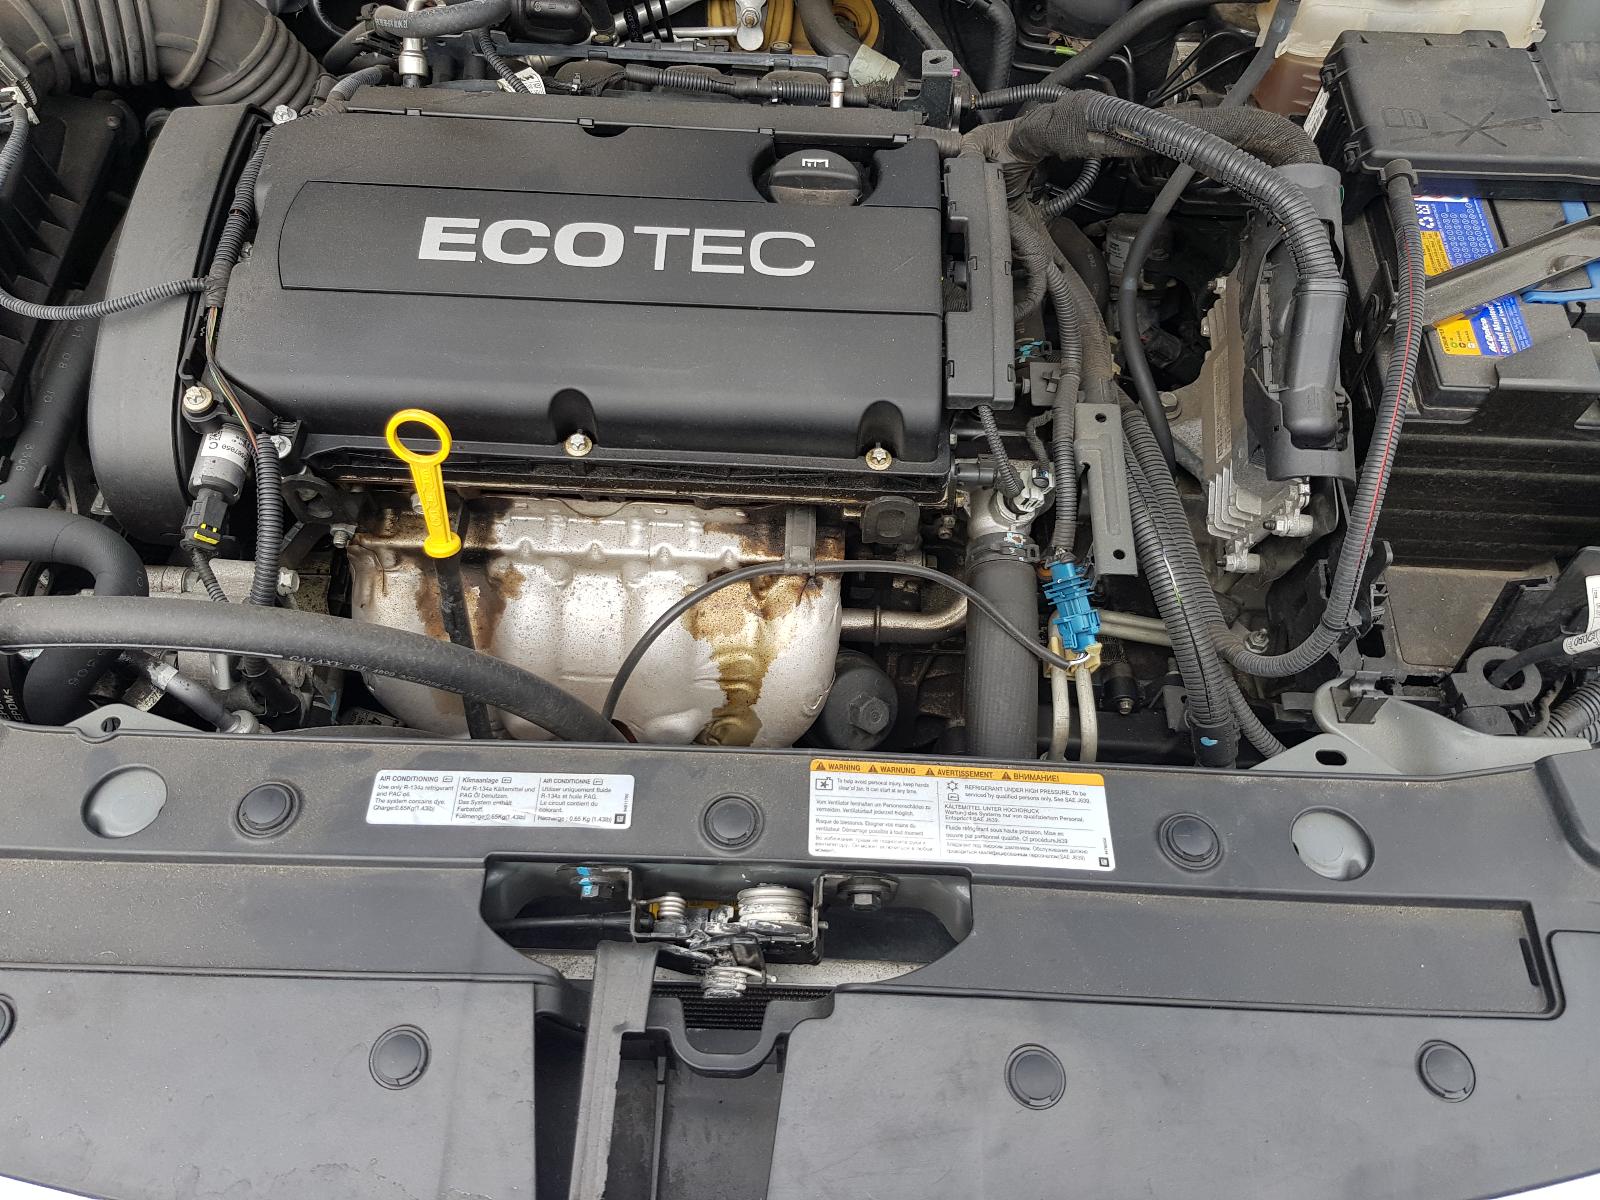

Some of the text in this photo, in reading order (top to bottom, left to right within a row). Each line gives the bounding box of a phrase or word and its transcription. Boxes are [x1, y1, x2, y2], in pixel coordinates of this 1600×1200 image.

[418, 217, 816, 276] ECOTEC
[828, 763, 994, 779] WARNING WARNUNG AVERTISSEMENT
[462, 776, 499, 784] Klimaanlage
[1013, 772, 1060, 783] ВНИМАНИЕ!
[964, 784, 1003, 792] REFRIGERANT
